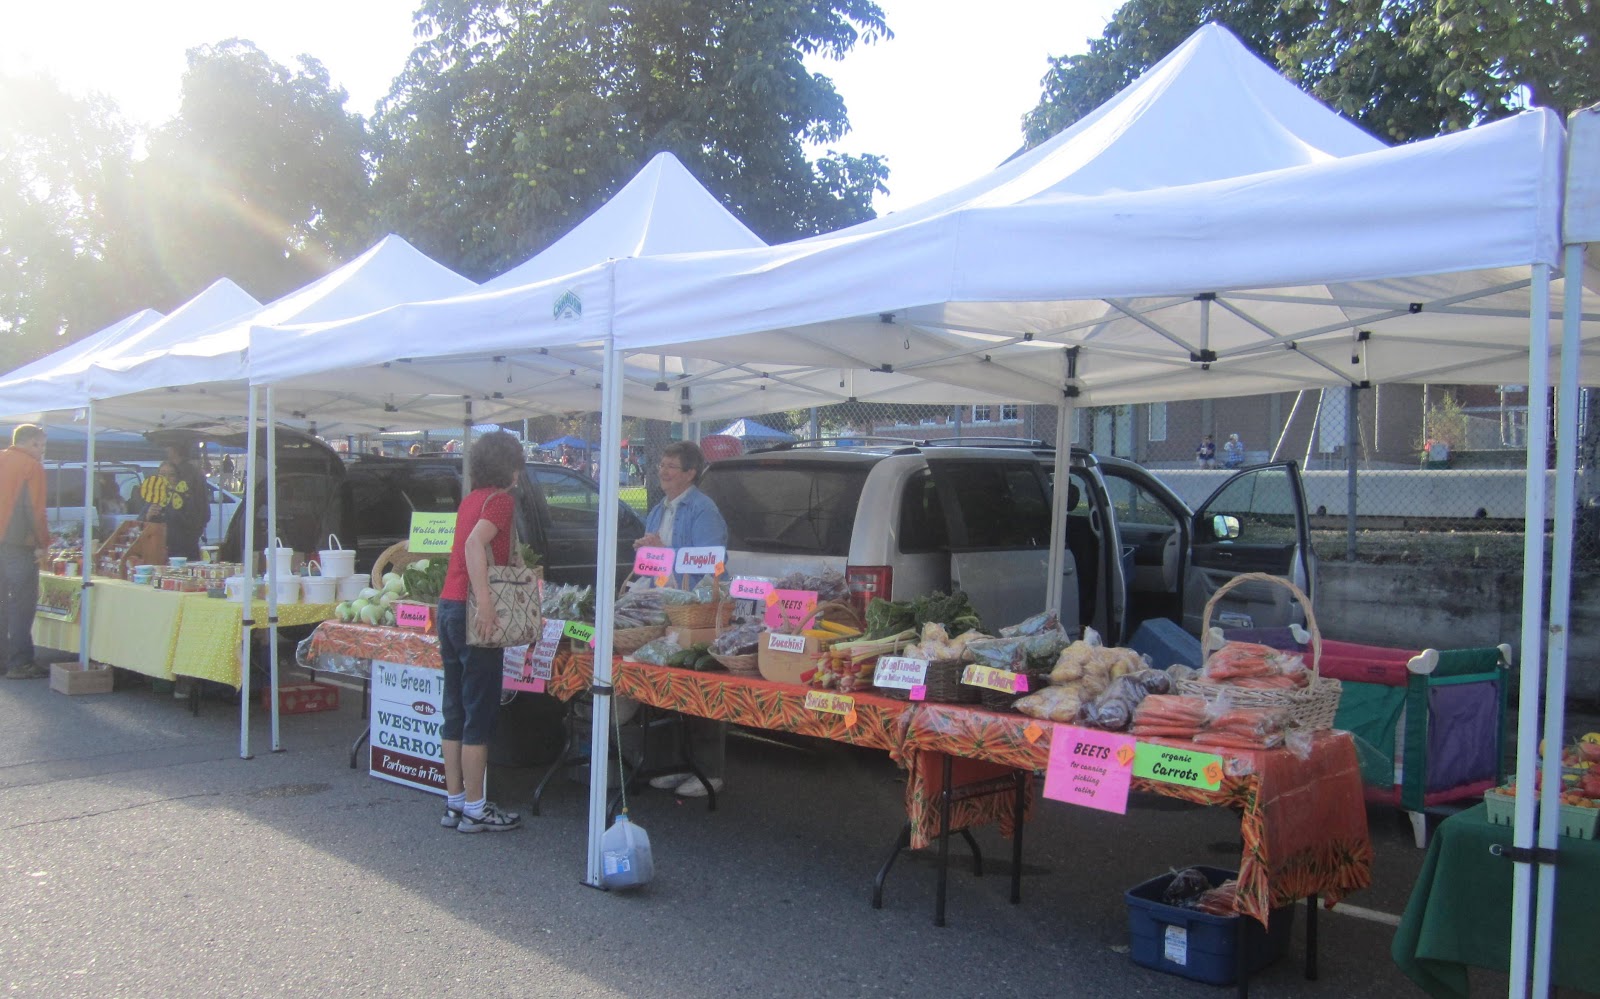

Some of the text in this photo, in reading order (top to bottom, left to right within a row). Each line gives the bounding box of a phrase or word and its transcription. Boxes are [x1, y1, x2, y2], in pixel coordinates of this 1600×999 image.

[413, 526, 456, 534] Walla Wall
[646, 552, 665, 560] Beet
[683, 552, 716, 568] Arugula
[639, 563, 667, 572] Greens
[737, 584, 765, 594] Beets
[401, 610, 426, 621] Romaine
[569, 625, 592, 640] Parsley
[770, 636, 803, 651] Zucchini
[379, 665, 397, 687] Two
[401, 669, 431, 694] Green
[415, 704, 434, 713] and the
[1073, 742, 1111, 759] BEETS
[1161, 753, 1192, 762] organic
[382, 755, 418, 777] Partners
[418, 766, 427, 779] in
[1080, 765, 1107, 775] canning
[1152, 762, 1198, 780] Carrots
[1073, 774, 1100, 786] pickling
[1074, 786, 1096, 797] eating
